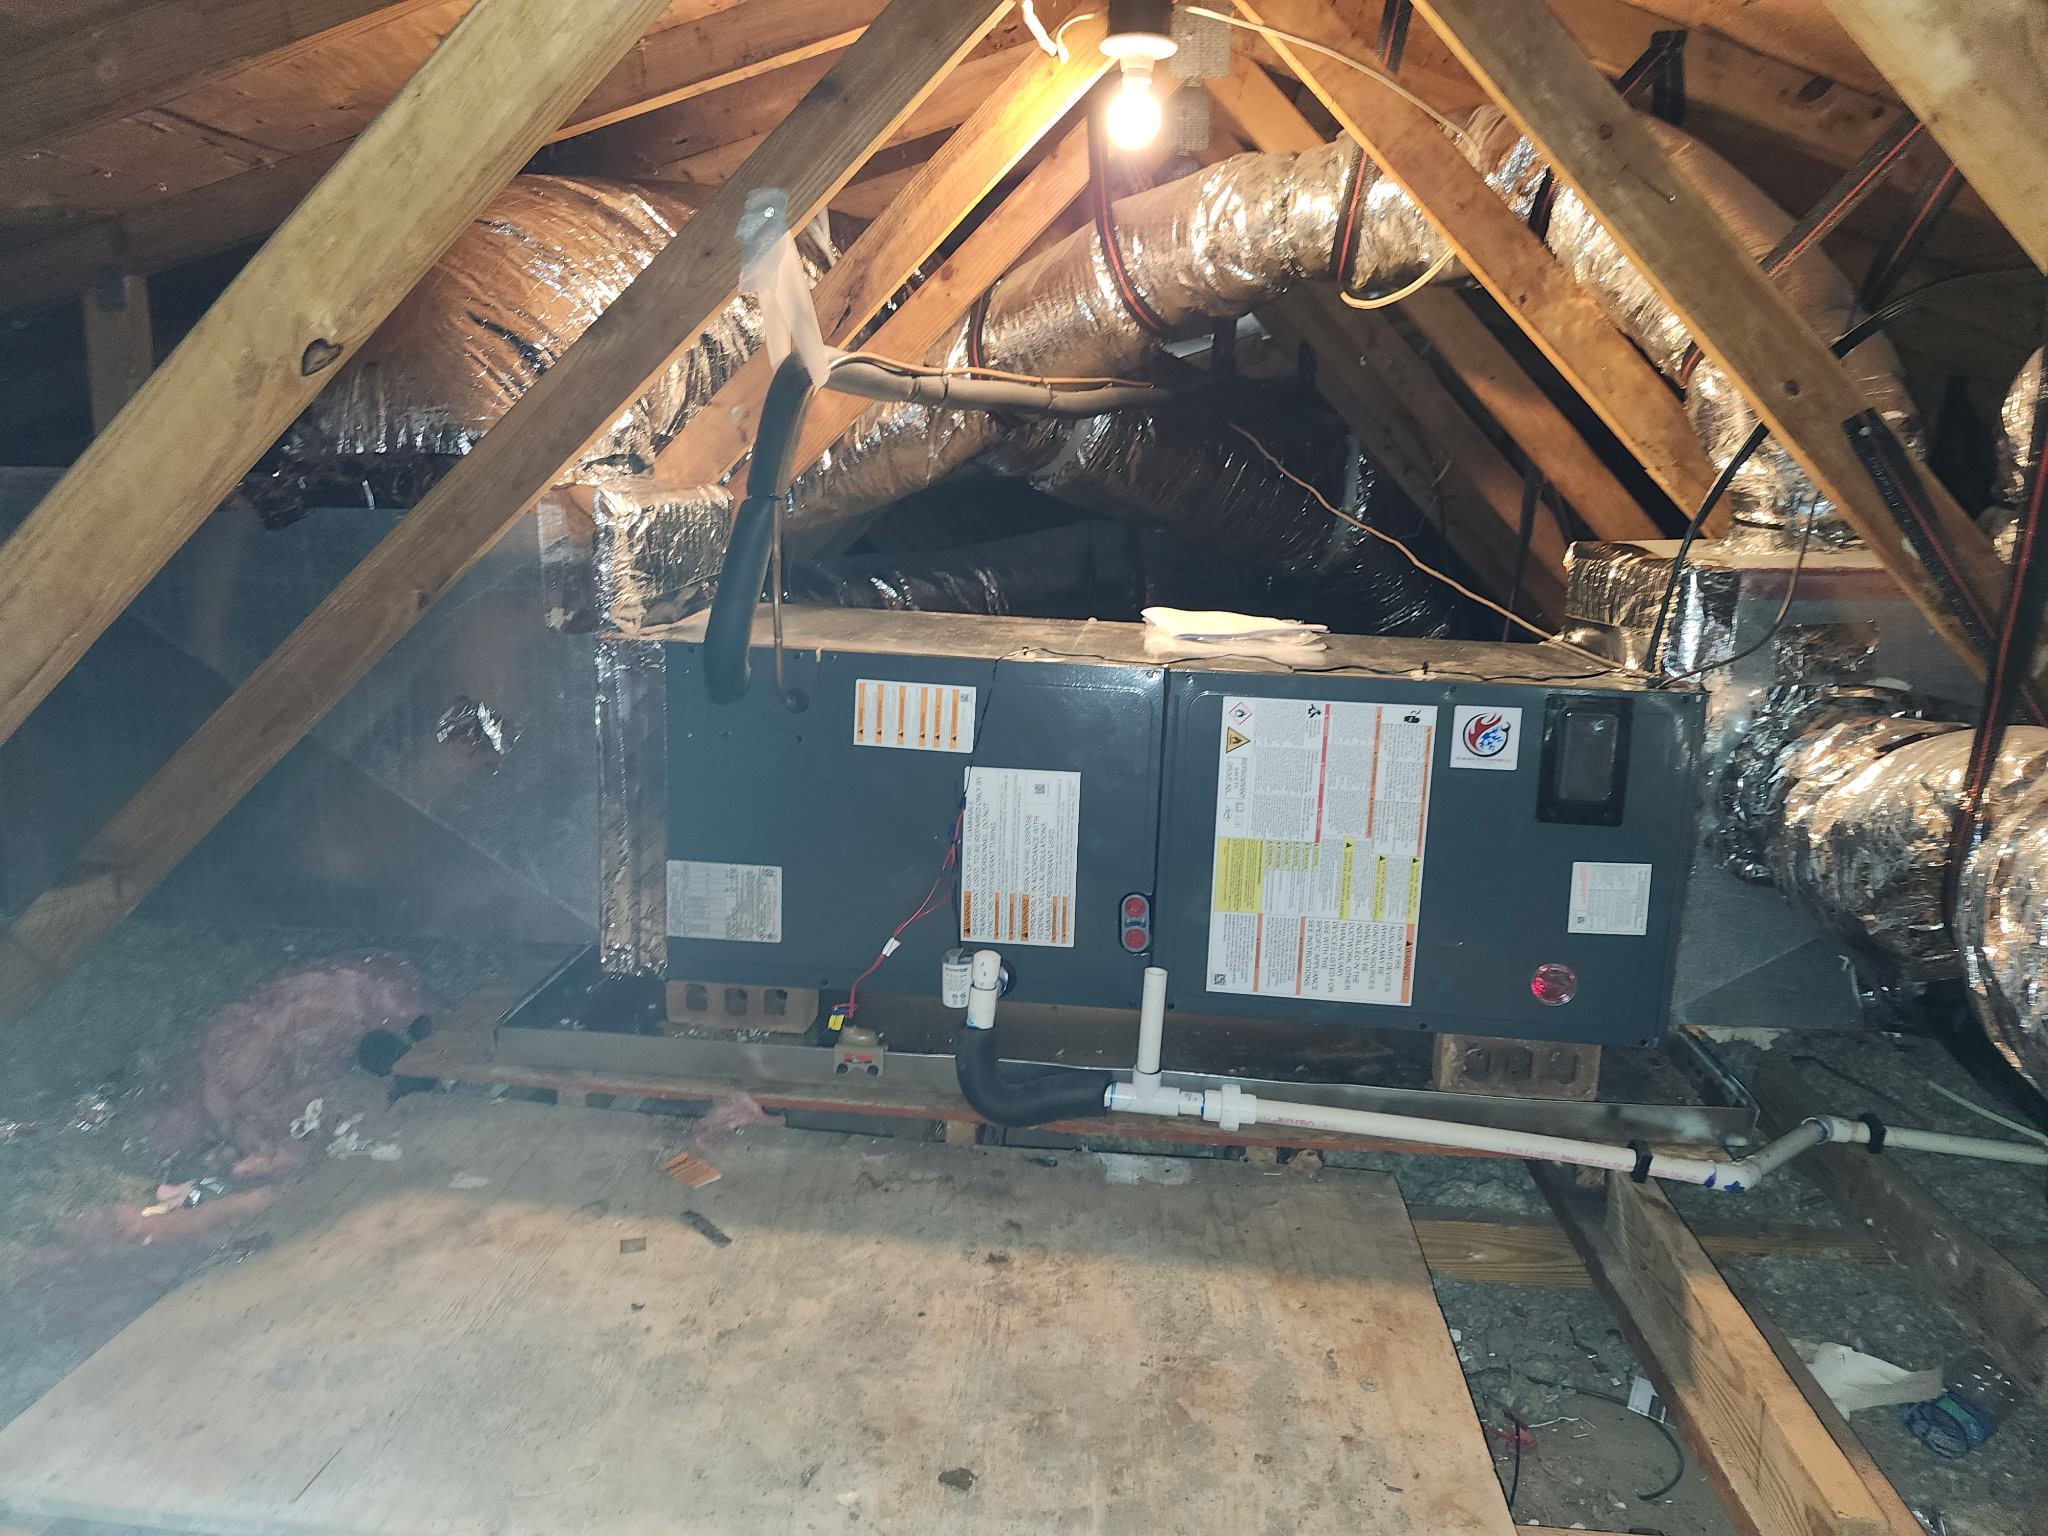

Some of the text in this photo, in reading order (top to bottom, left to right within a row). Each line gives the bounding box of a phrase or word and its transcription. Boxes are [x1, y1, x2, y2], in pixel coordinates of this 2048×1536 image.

[976, 777, 982, 785] BY
[974, 844, 980, 853] BE
[974, 854, 980, 864] TO
[966, 863, 972, 872] OF
[1038, 898, 1044, 907] OR
[1354, 923, 1363, 960] INSTALLED
[1337, 943, 1345, 977] AUXILIARY
[1384, 925, 1395, 992] AUXILIARY DEVICES
[1403, 947, 1413, 980] WARNING
[1378, 967, 1384, 975] BE
